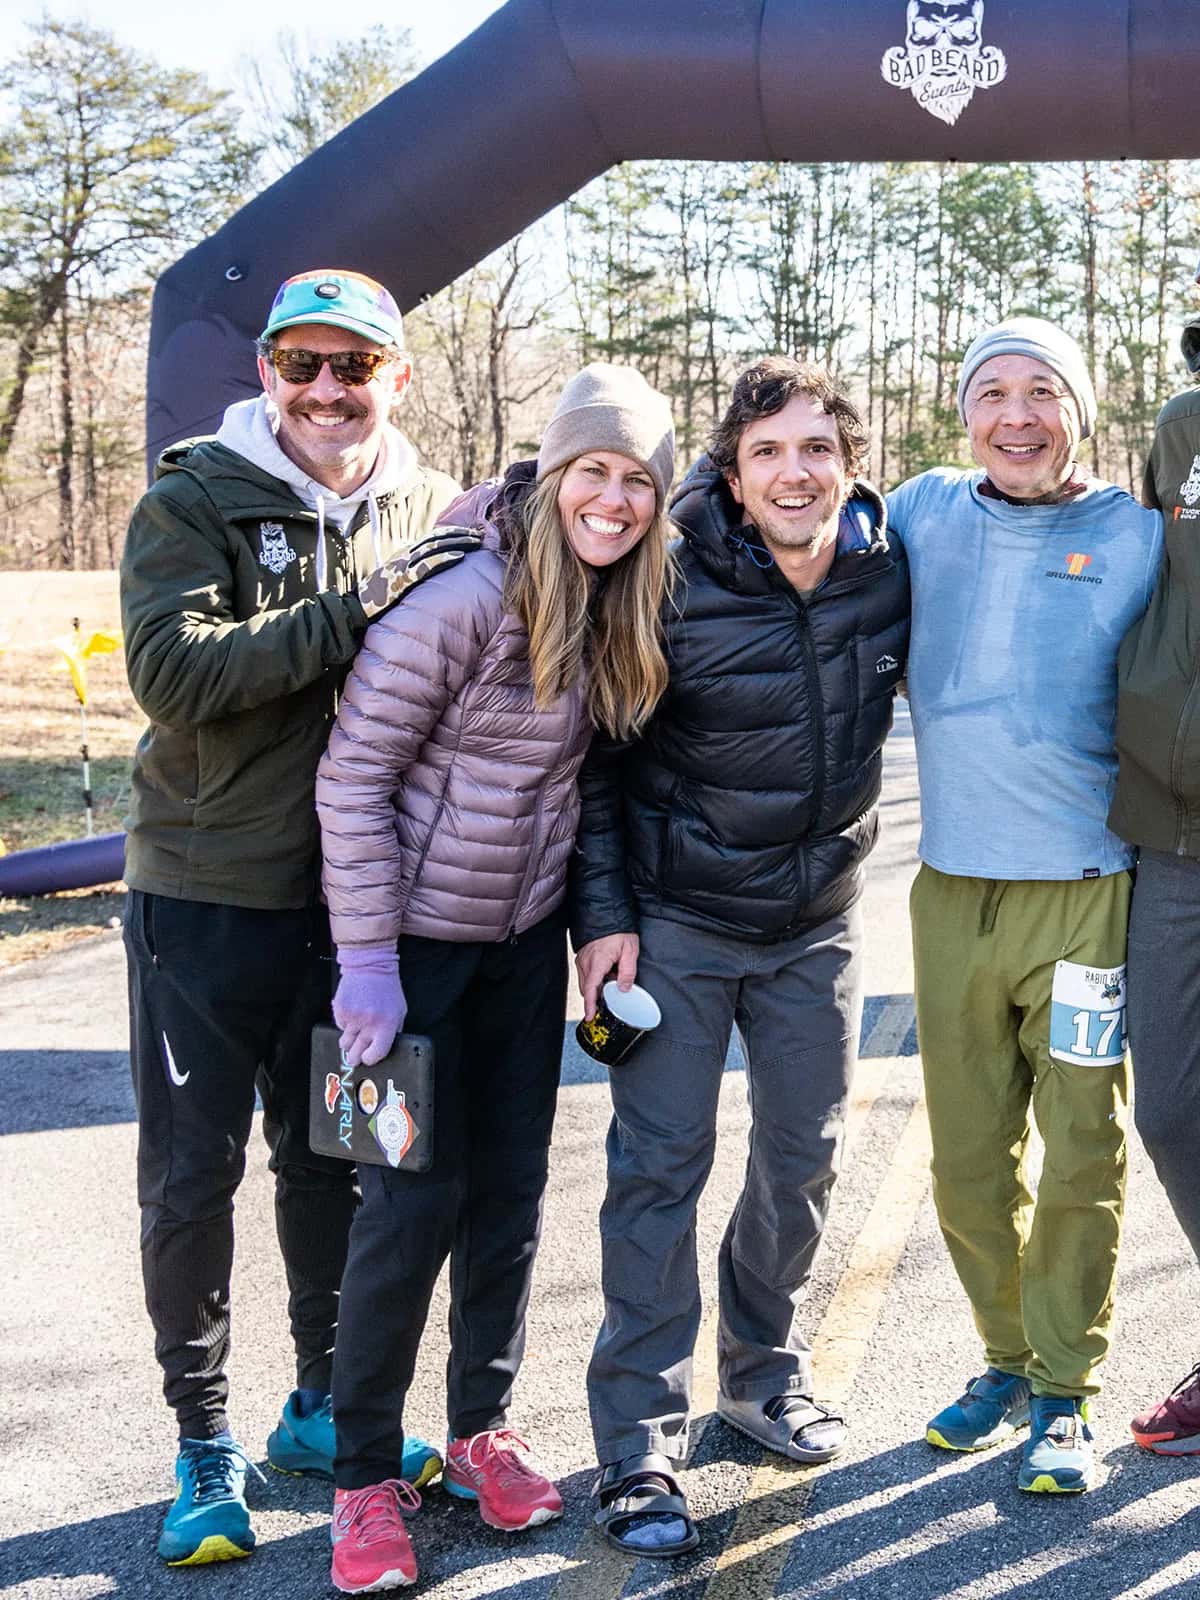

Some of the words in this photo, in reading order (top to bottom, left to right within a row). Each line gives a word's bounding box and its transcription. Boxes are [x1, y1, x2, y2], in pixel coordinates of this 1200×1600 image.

[889, 54, 926, 82] BAD
[931, 49, 1000, 82] BEARD
[919, 78, 971, 102] Events
[1053, 571, 1103, 584] RUNNING
